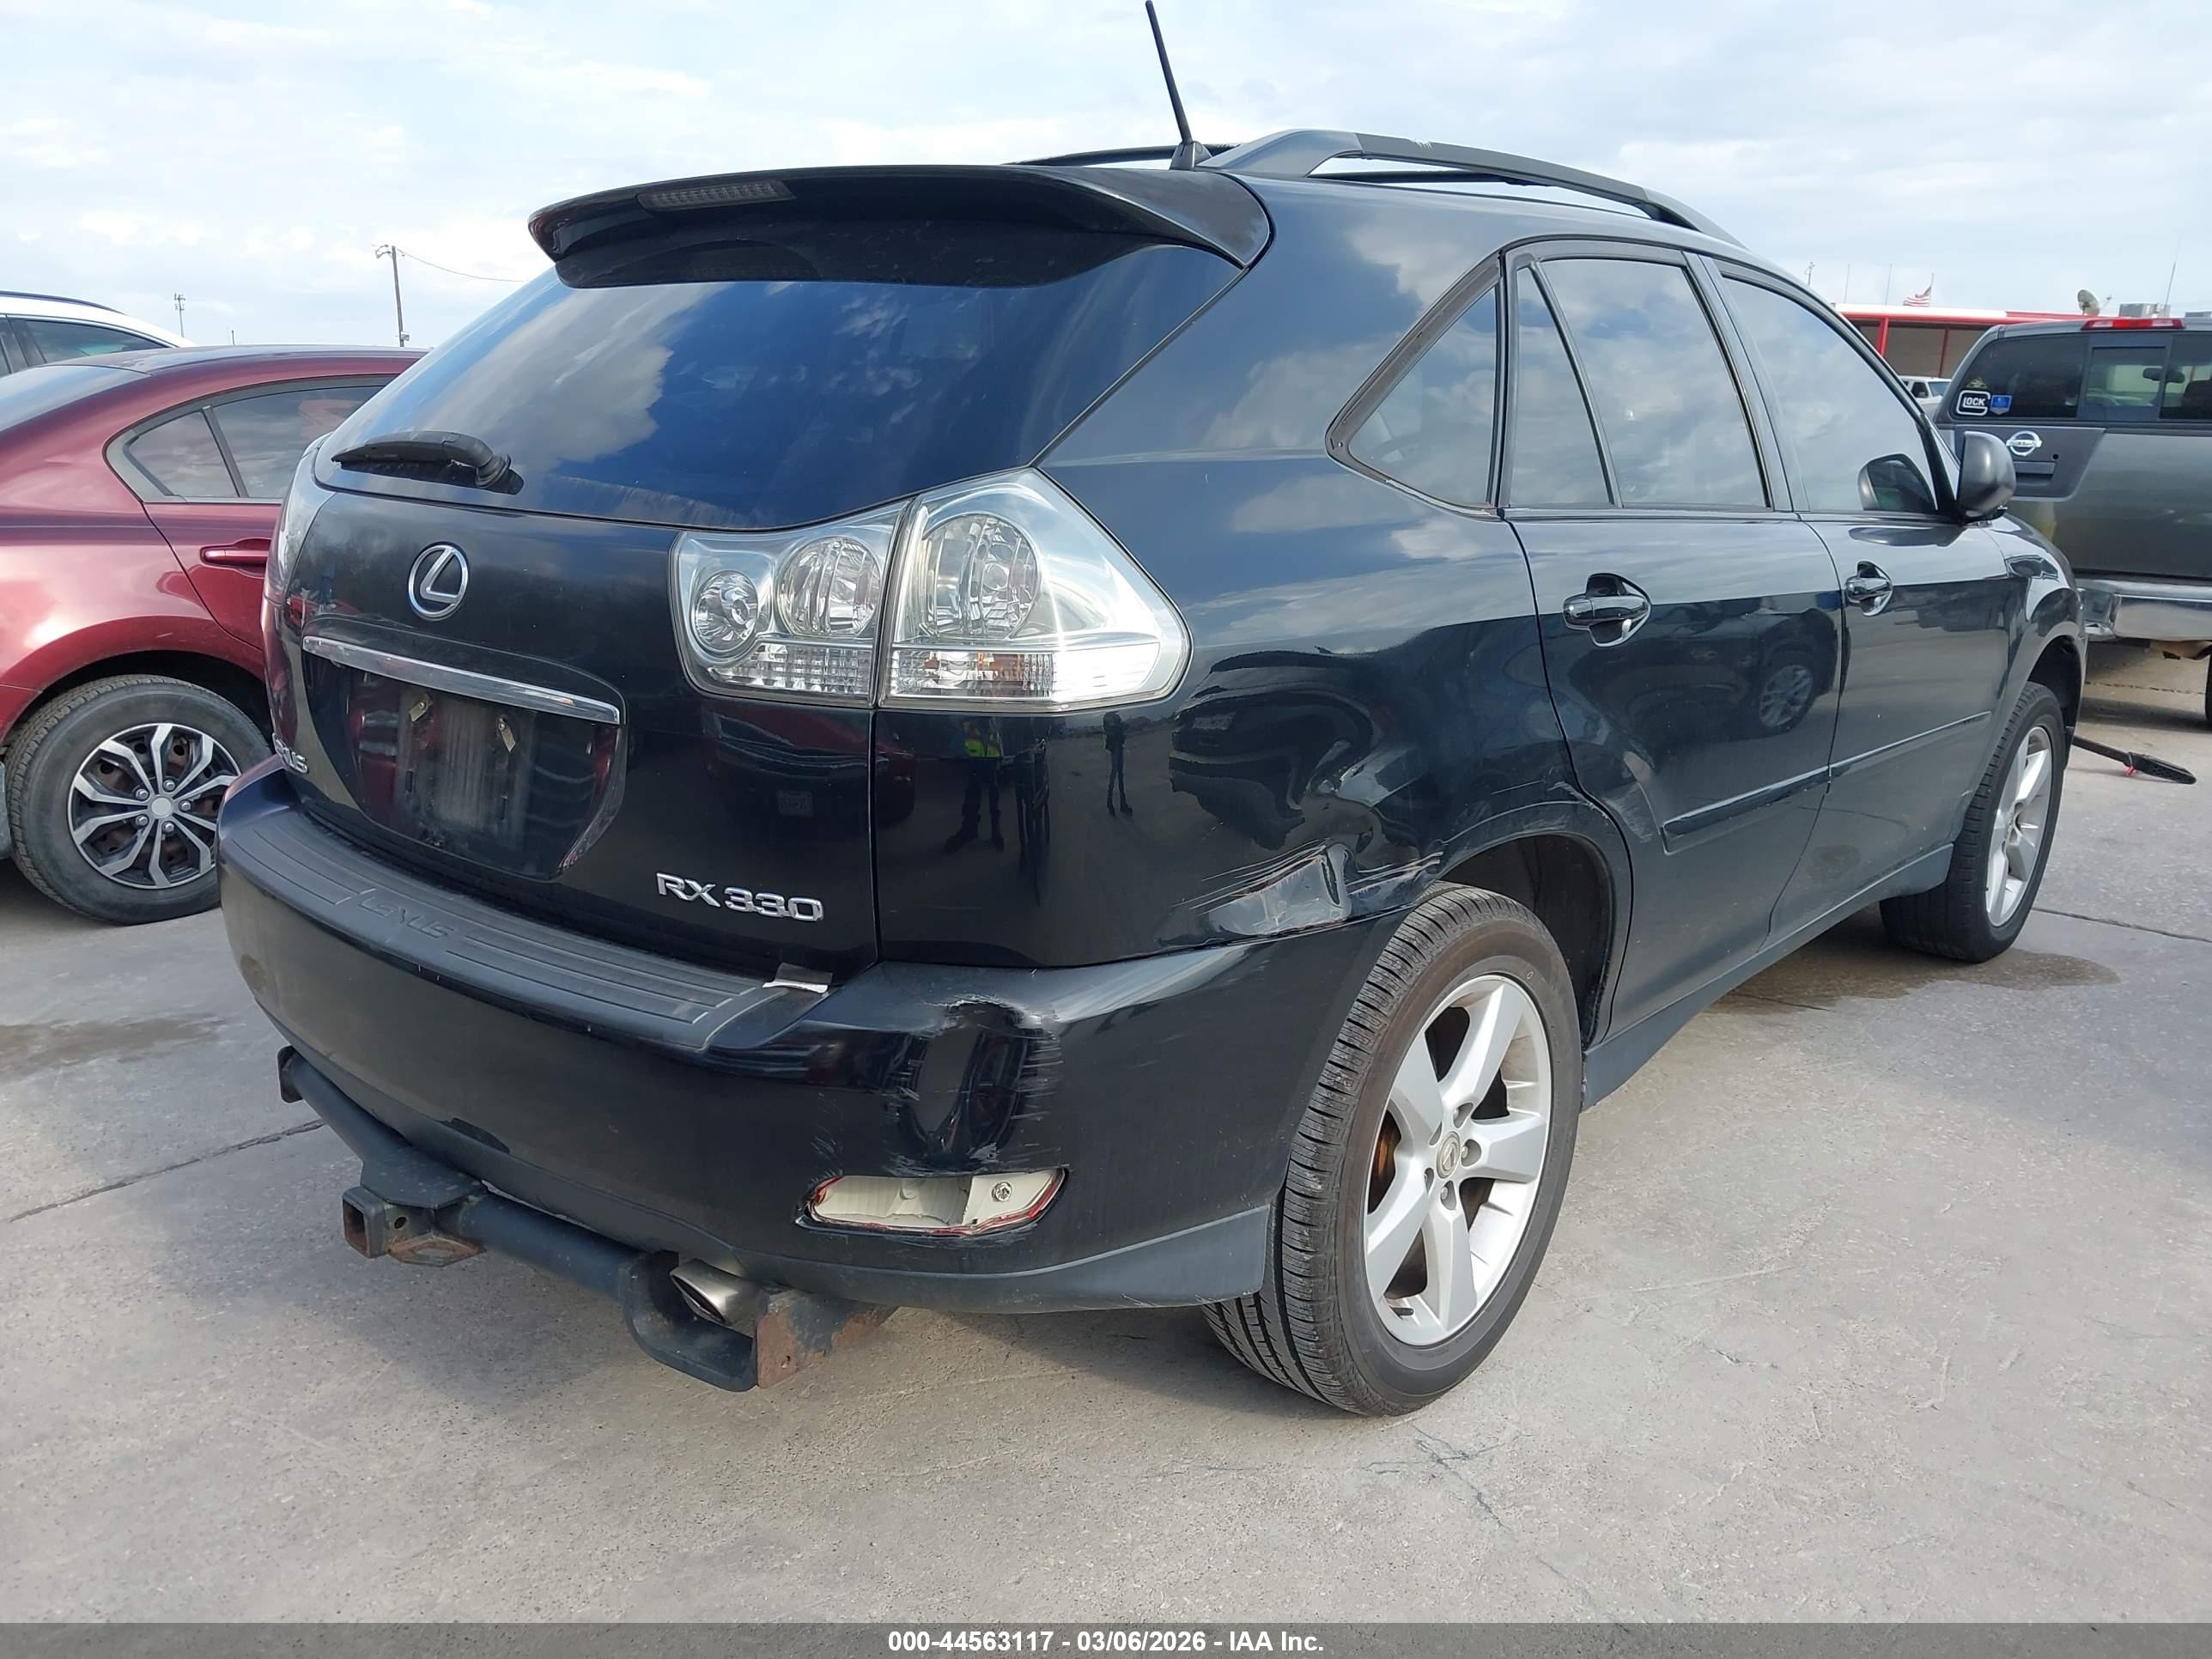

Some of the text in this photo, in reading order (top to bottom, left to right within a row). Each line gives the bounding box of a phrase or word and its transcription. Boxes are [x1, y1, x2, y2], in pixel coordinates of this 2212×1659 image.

[357, 895, 454, 939] LEXUS
[656, 872, 824, 921] RX 330
